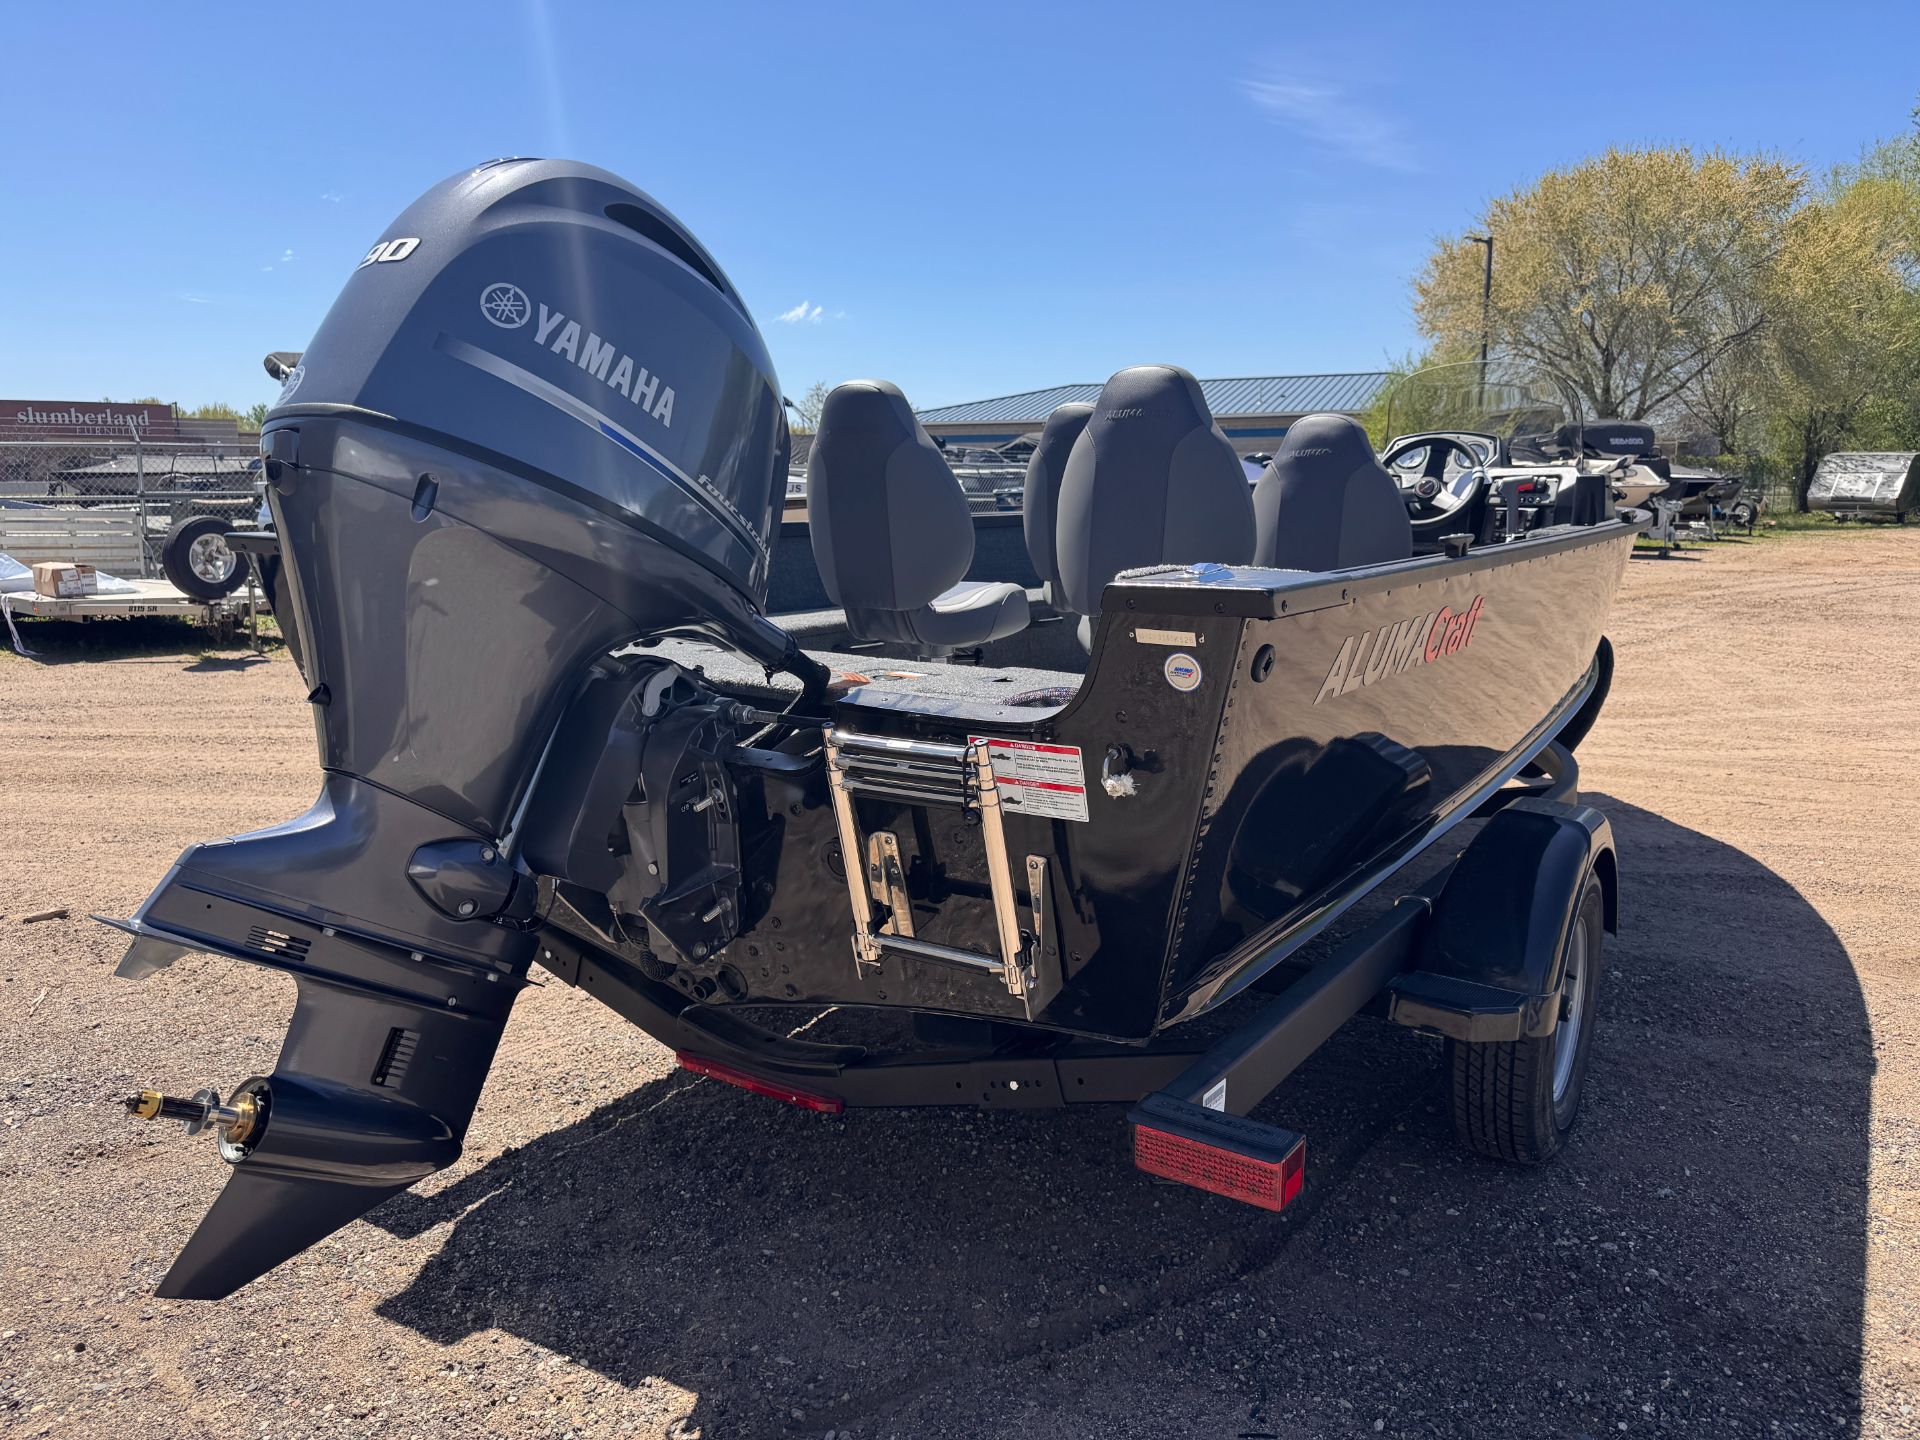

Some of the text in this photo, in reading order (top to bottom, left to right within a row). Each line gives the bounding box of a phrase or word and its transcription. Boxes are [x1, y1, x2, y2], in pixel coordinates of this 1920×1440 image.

[356, 237, 421, 271] 90
[533, 302, 675, 428] YAMAHA
[16, 406, 150, 426] slumberland
[788, 484, 802, 493] JS
